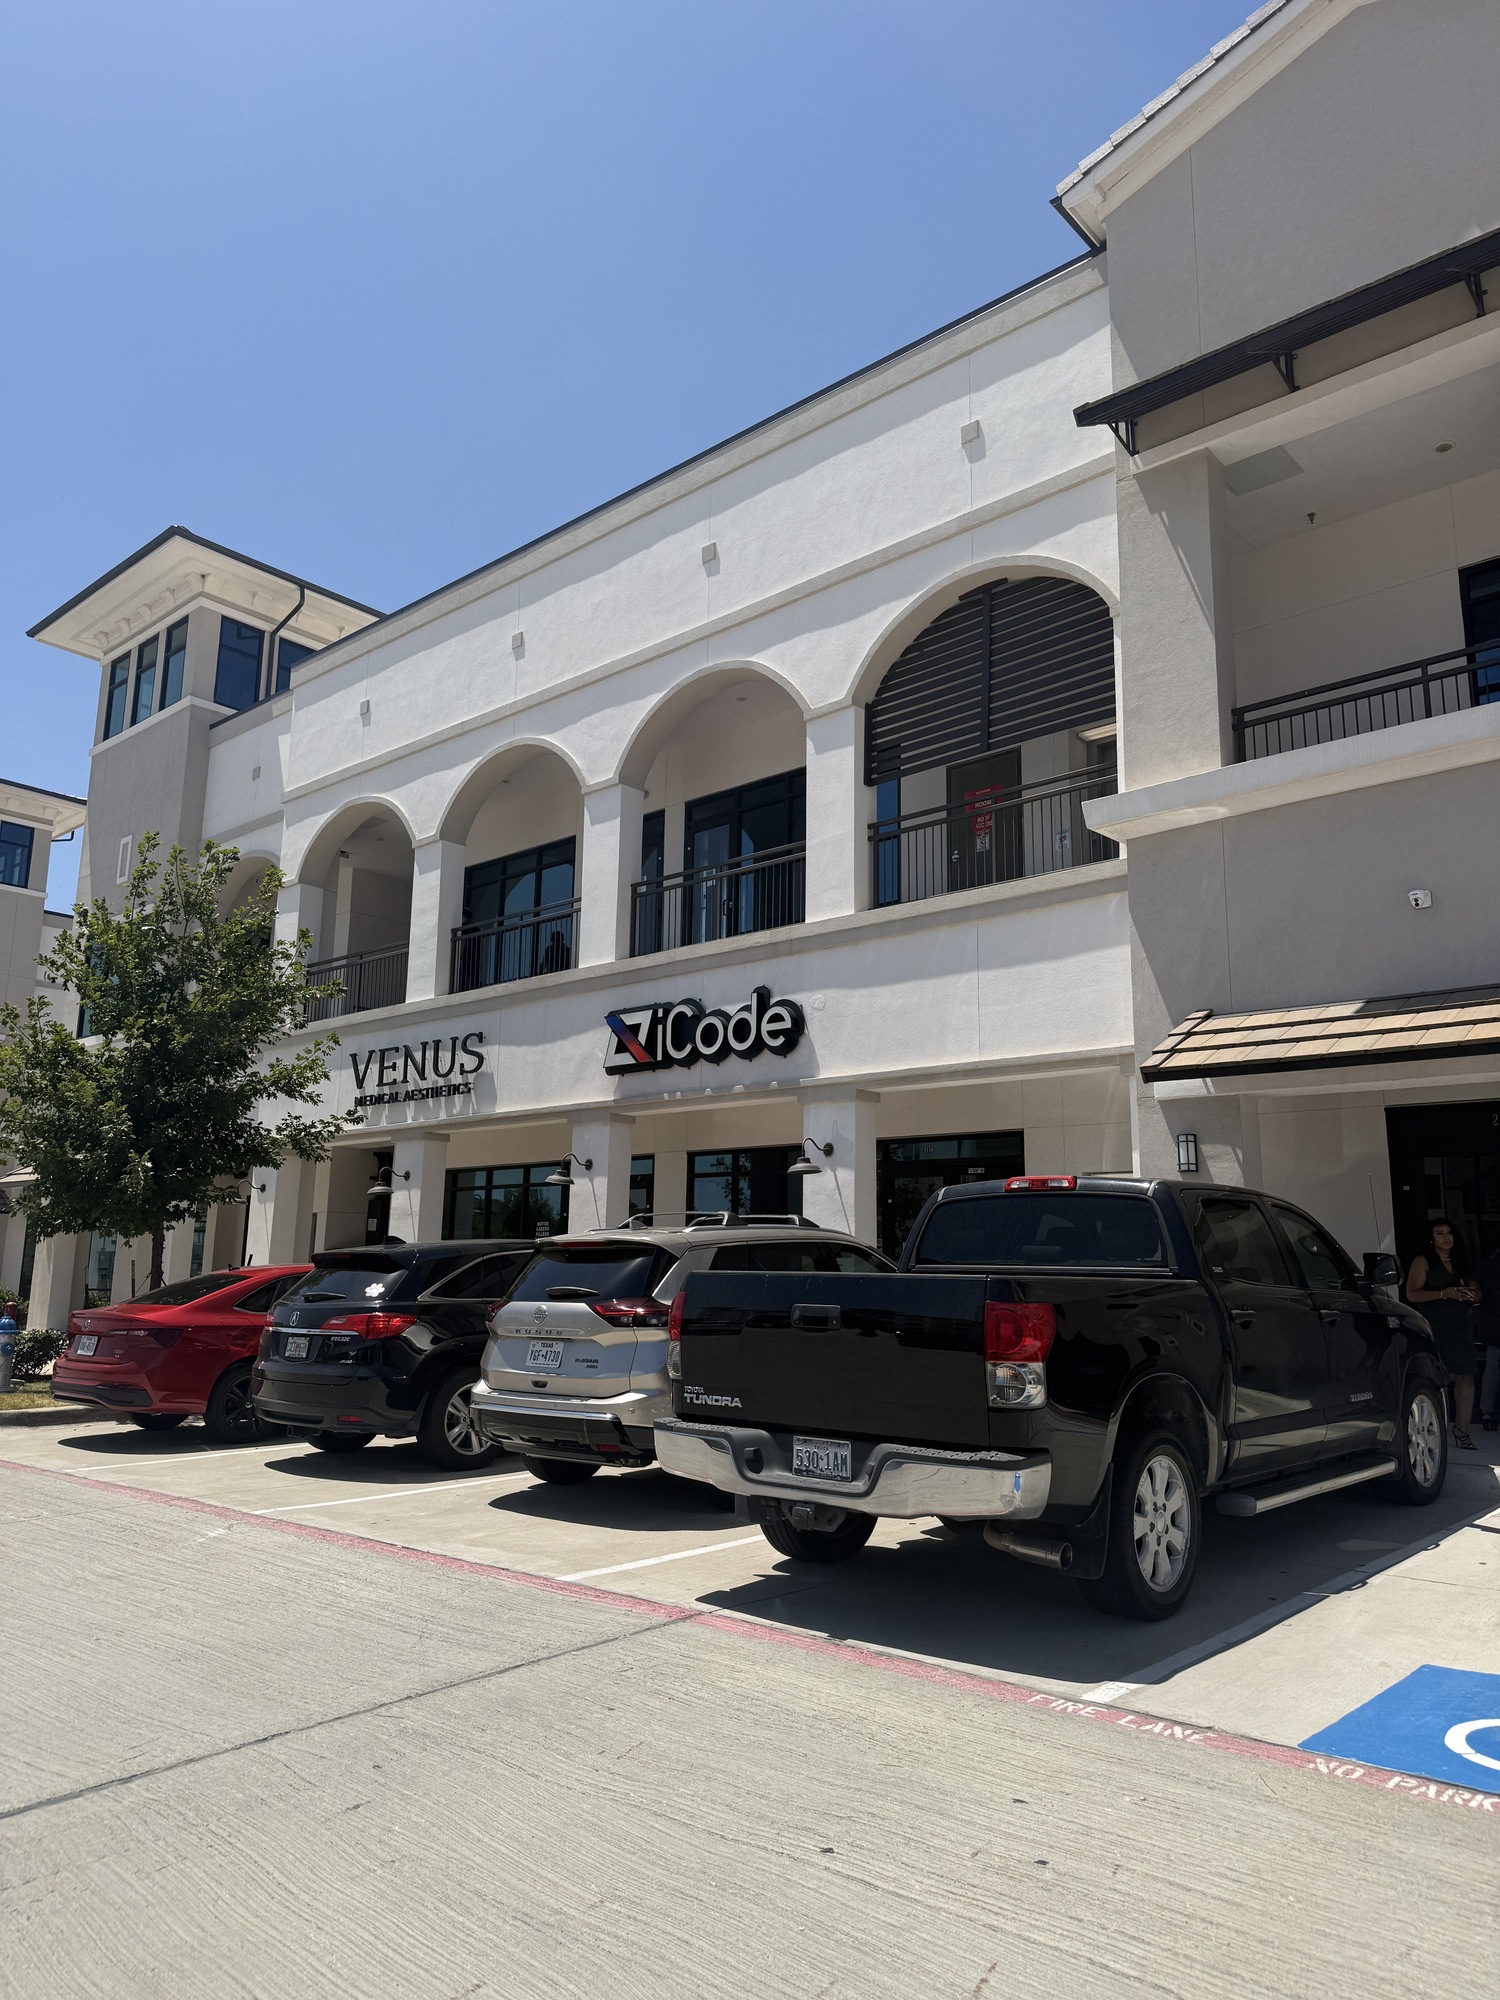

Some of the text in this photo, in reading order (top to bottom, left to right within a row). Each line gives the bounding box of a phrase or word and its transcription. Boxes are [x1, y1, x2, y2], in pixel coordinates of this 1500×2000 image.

[974, 799, 992, 808] ROOM
[656, 988, 796, 1062] iCode
[349, 1031, 485, 1090] VENUS
[354, 1082, 472, 1107] MEDICAL AESTHETICS
[683, 1393, 743, 1408] TUNDRA
[684, 1385, 705, 1393] TOYOTA
[1028, 1694, 1218, 1746] FIRE LANE
[1307, 1757, 1500, 1812] NO PARK
